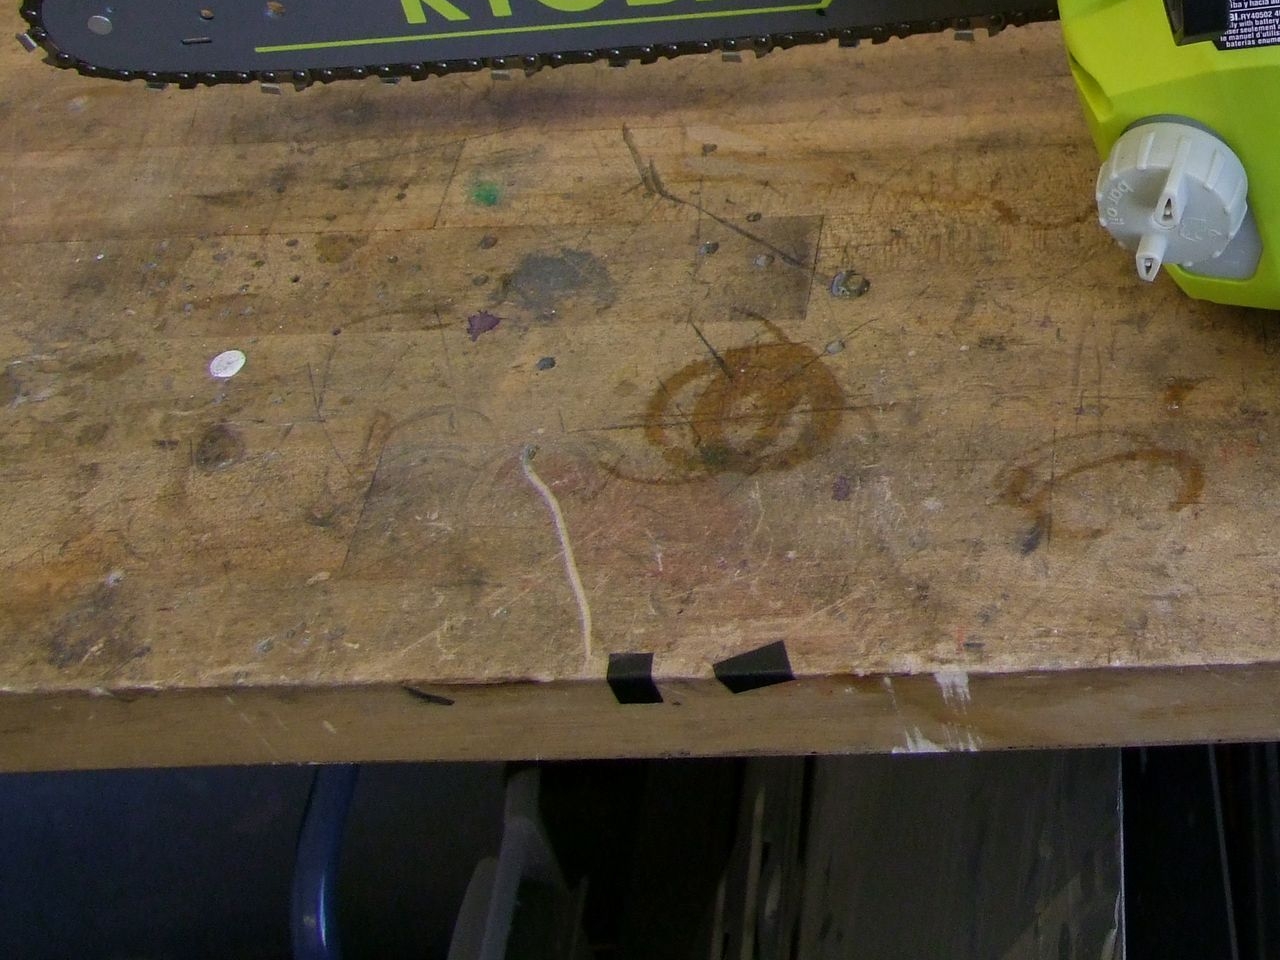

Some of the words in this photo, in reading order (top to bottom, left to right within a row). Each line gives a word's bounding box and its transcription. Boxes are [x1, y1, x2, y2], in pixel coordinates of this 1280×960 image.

[1238, 19, 1253, 27] with
[1240, 25, 1276, 33] seulement
[1108, 180, 1135, 205] bar
